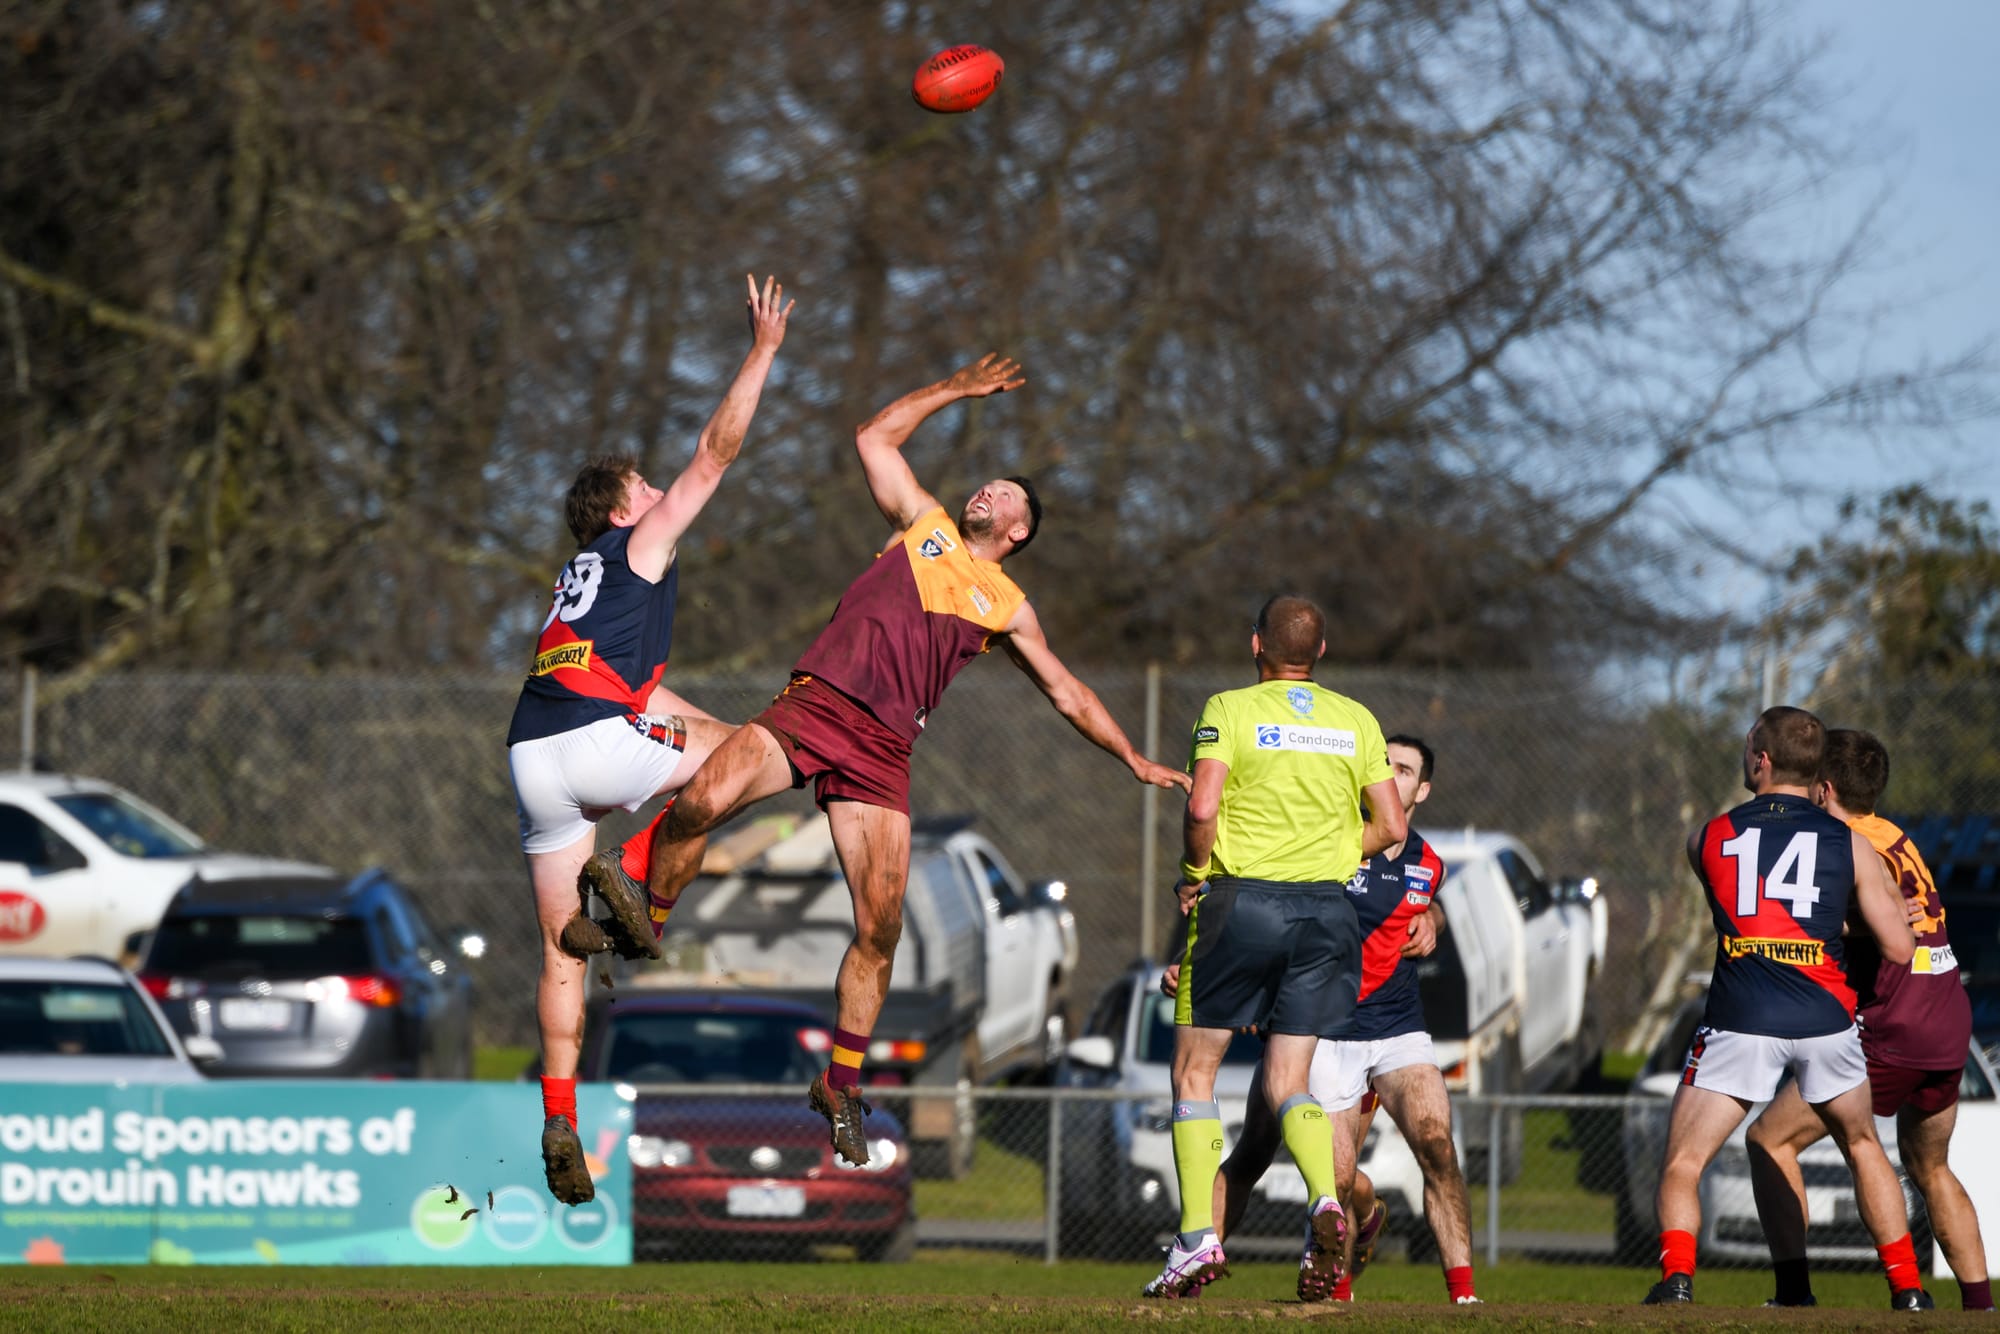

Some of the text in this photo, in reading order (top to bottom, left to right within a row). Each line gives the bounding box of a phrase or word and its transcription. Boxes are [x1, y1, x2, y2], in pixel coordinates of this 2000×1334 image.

[1288, 732, 1355, 750] Candappa
[1721, 826, 1821, 919] 14
[1766, 943, 1820, 965] TWENTY
[0, 1107, 416, 1161] oud Sponsors of
[1, 1157, 362, 1207] Drouin Hawks
